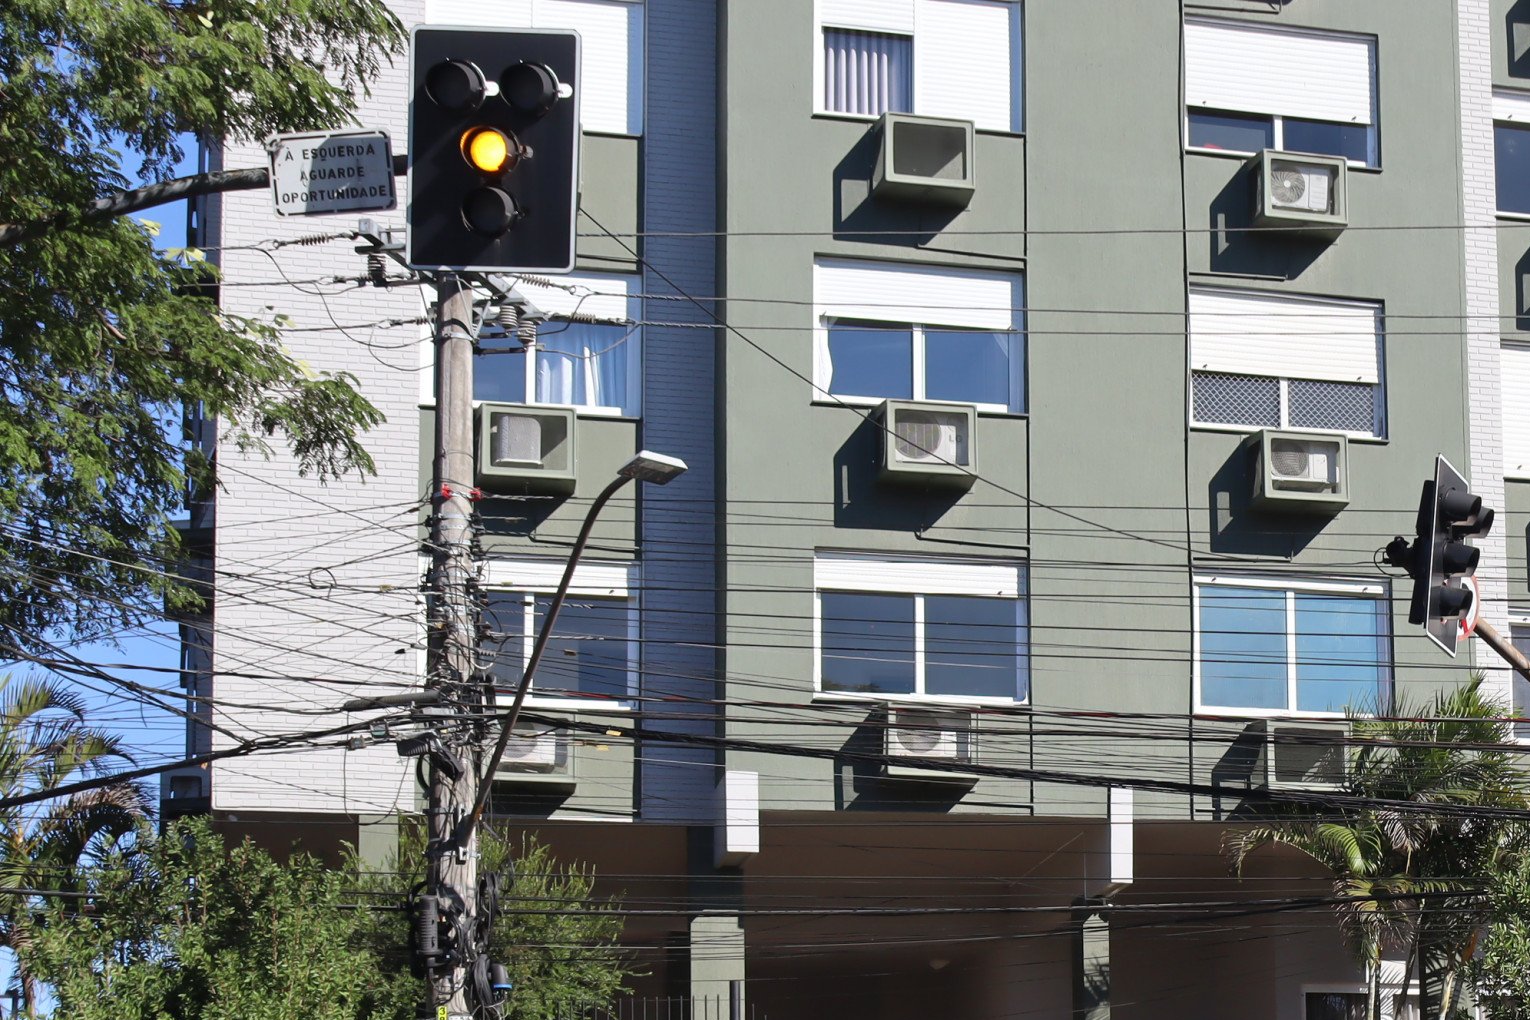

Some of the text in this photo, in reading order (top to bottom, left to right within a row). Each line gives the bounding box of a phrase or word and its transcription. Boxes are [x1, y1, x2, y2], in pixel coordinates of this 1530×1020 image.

[284, 144, 375, 162] À ESQUERDA
[300, 166, 365, 181] AGUARDE
[282, 185, 387, 203] OPORTUNIDADE
